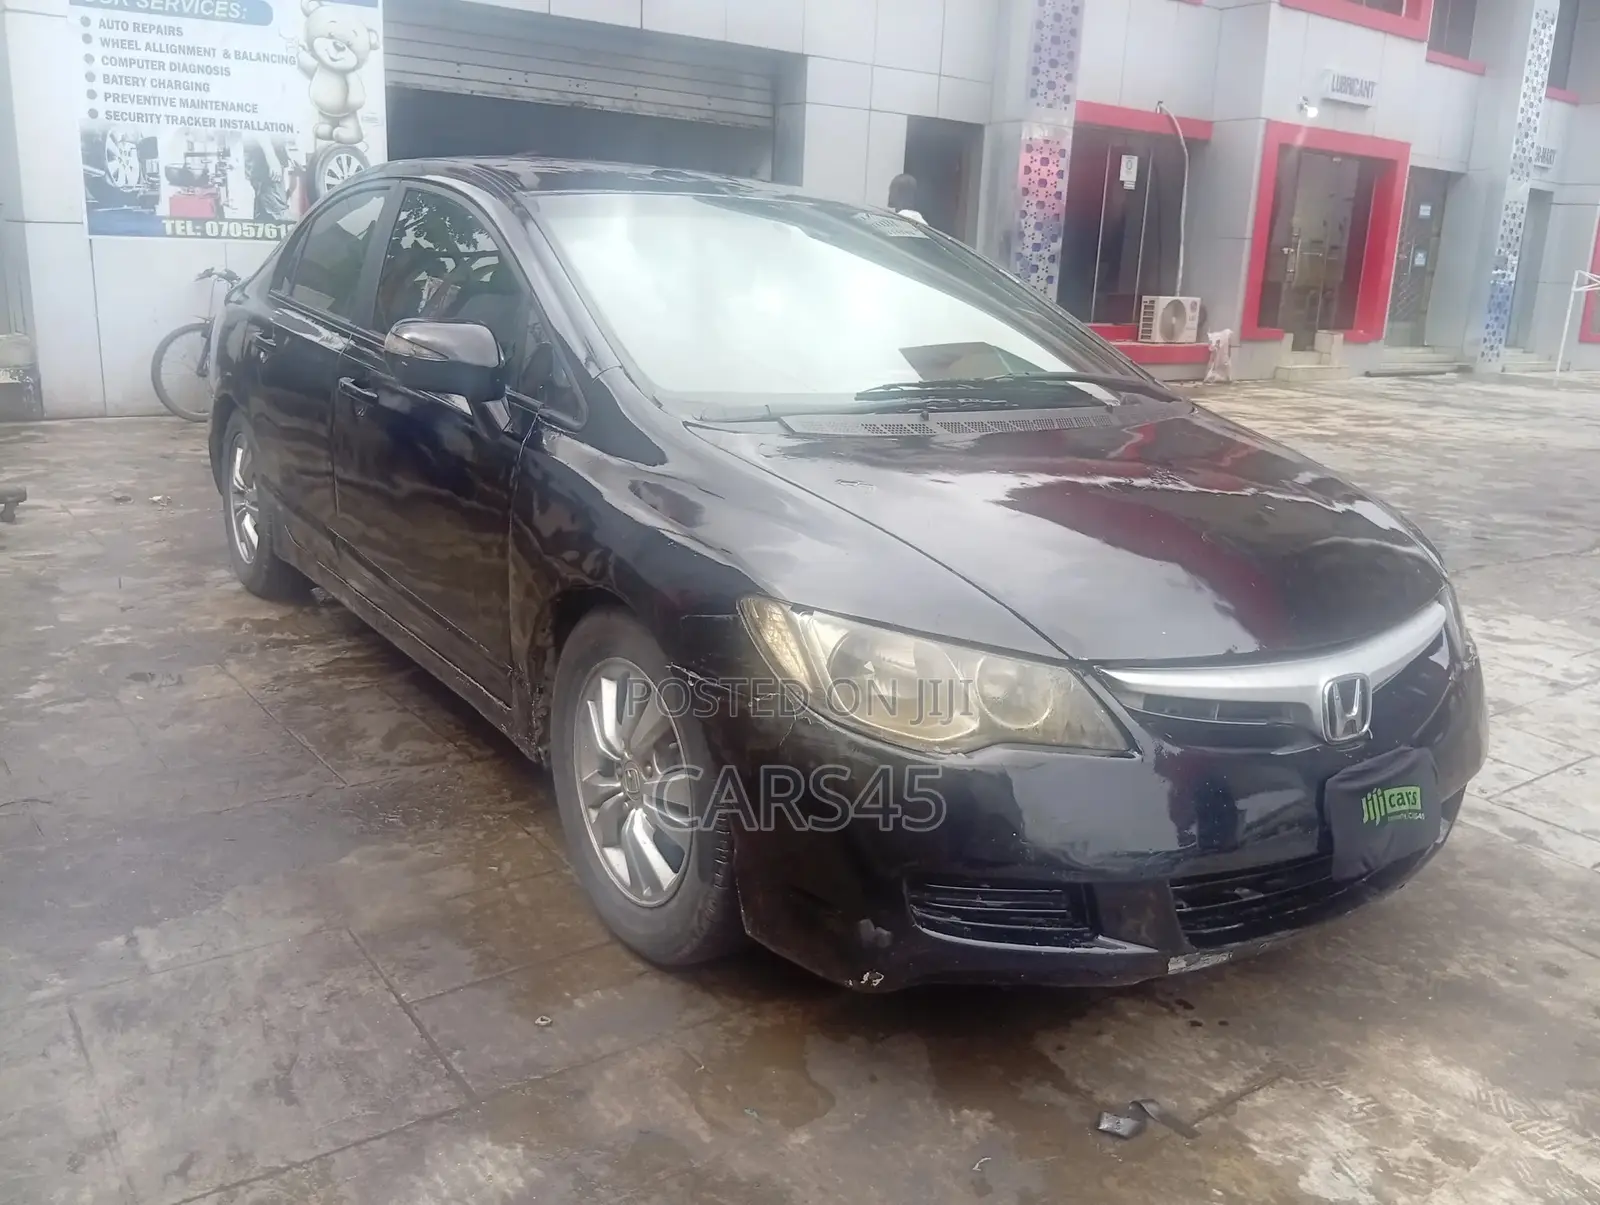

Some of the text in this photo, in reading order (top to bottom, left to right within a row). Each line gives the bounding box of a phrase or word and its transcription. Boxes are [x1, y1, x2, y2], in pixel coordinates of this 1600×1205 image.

[99, 18, 184, 36] AUTO REPAIRS
[99, 37, 297, 65] WHEEL ALLIGNMENT & BALANCING
[101, 55, 231, 77] COMPUTER DIAGNOSIS
[103, 74, 211, 93] BATERY CHARGING
[1331, 73, 1378, 99] LUBRICANT
[104, 92, 259, 114] PREVENTIVE MAINTENANCE
[105, 110, 162, 125] SECURITY
[164, 114, 216, 128] TRACKER
[162, 219, 201, 236] TEL:
[1388, 791, 1418, 808] cars
